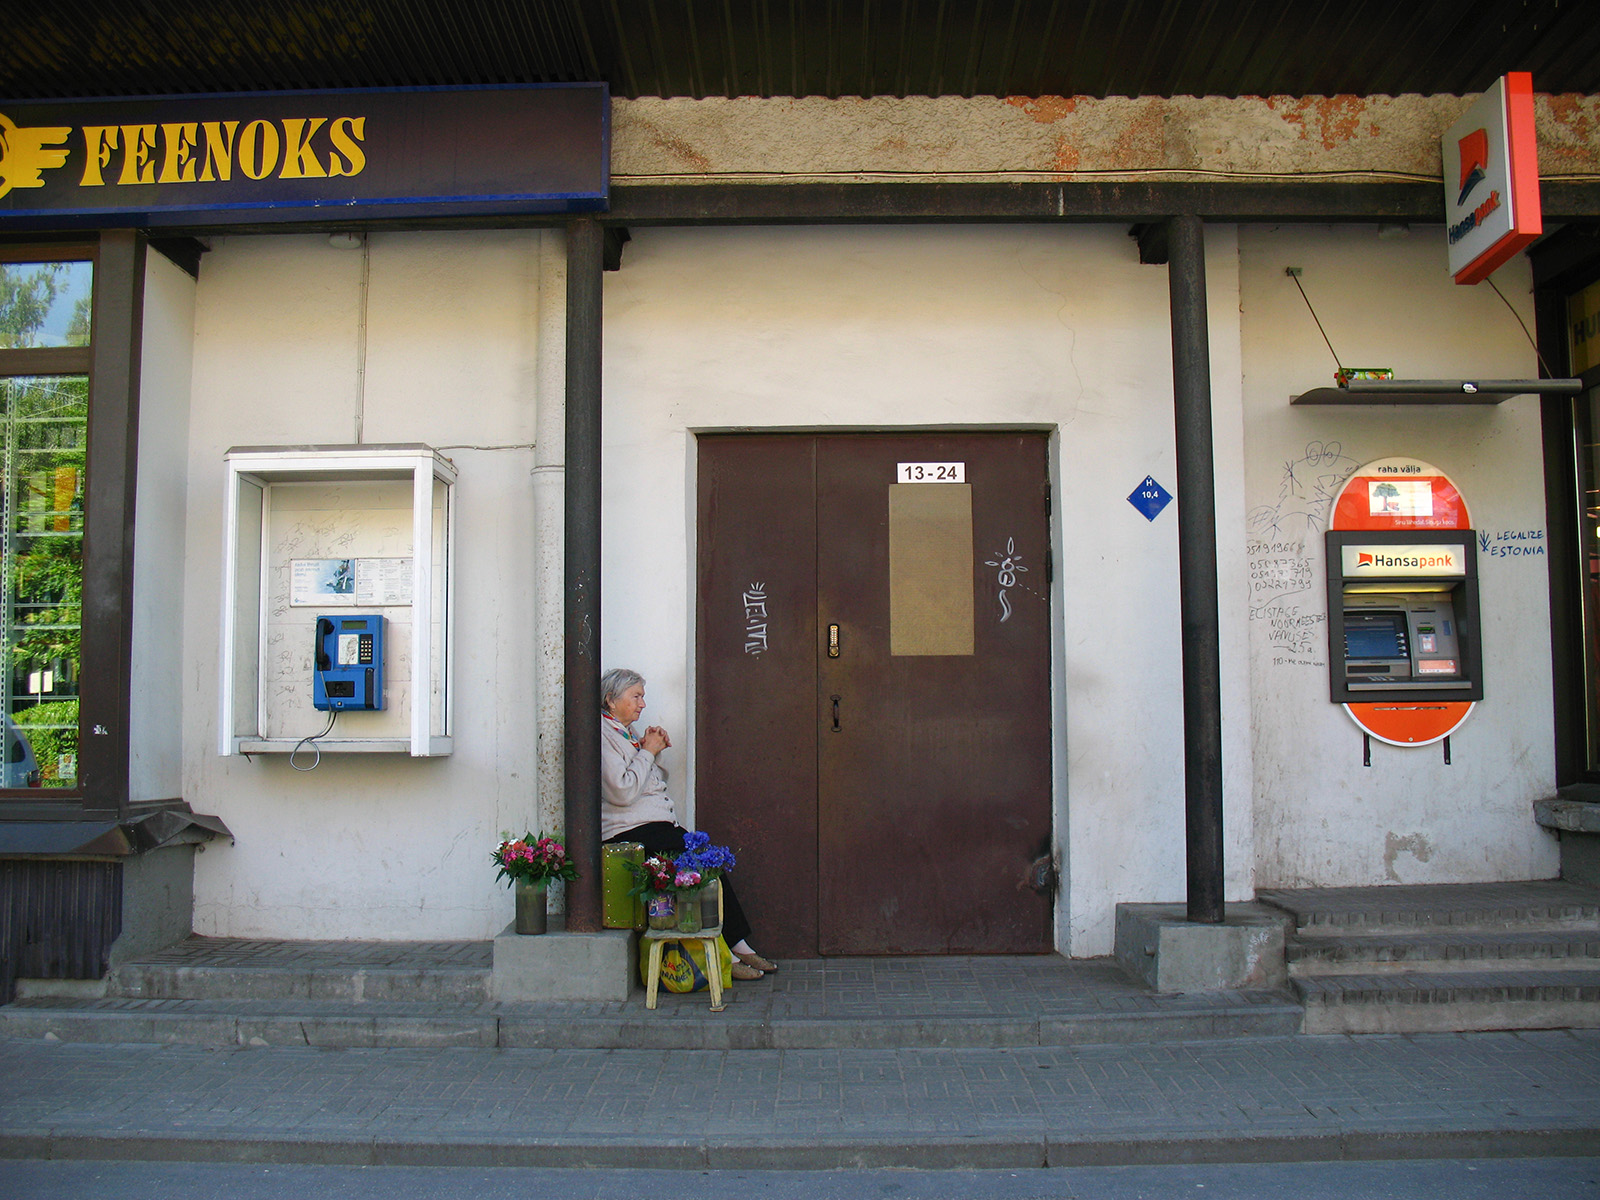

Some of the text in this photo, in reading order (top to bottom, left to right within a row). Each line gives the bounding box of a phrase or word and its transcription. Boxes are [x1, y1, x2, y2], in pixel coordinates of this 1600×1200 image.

[79, 117, 366, 187] FEENOKS
[1448, 190, 1501, 245] Hansapank
[1377, 464, 1421, 474] raha välja
[1142, 490, 1159, 499] 10,4
[1497, 530, 1544, 540] LEGALIZE
[1490, 545, 1545, 558] ESTONIA
[1375, 554, 1453, 569] Hansapank
